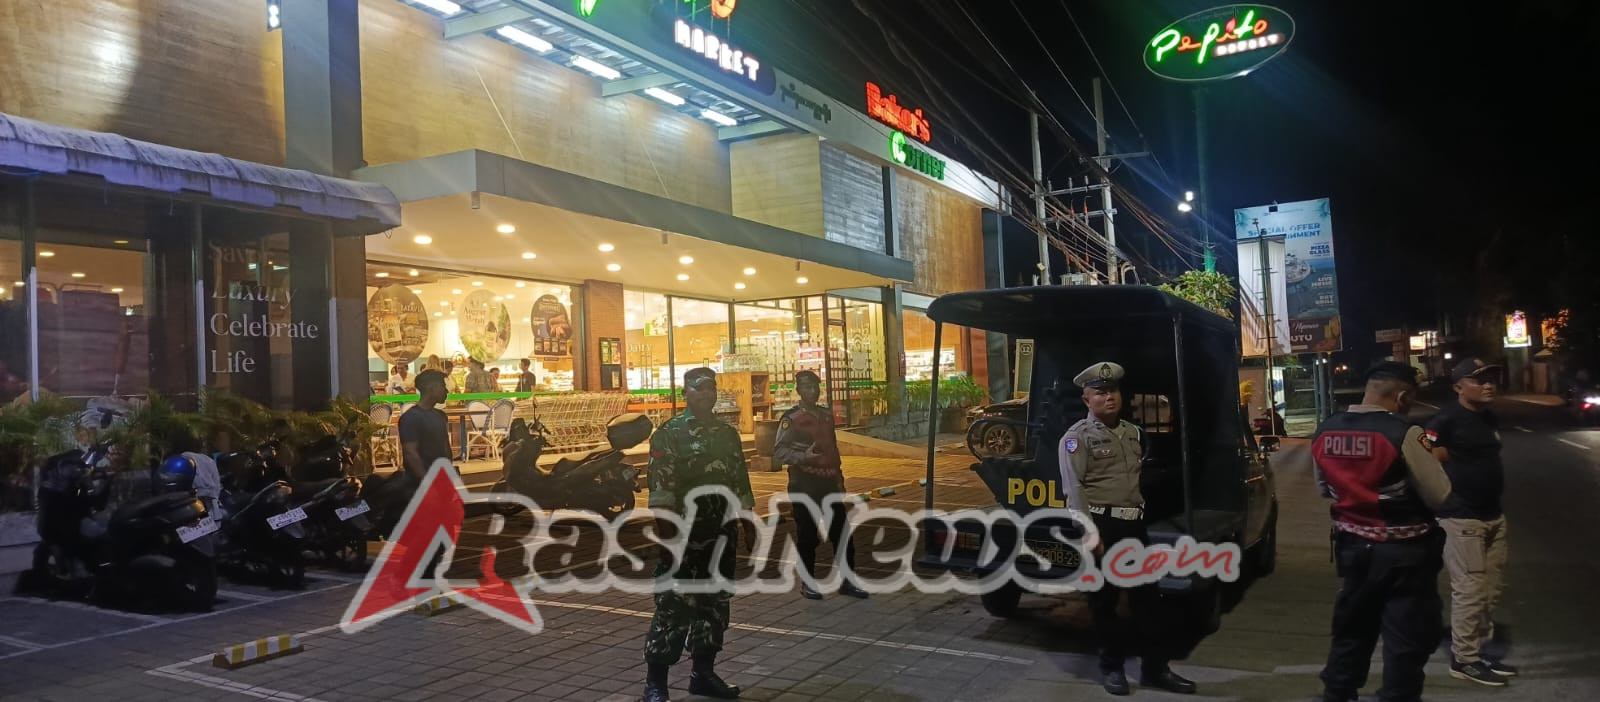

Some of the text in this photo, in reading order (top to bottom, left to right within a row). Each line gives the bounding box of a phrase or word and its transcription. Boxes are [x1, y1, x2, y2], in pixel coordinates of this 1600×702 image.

[674, 19, 760, 81] MARKET
[1151, 10, 1268, 64] Pepito
[866, 81, 932, 143] Baker's
[889, 131, 947, 181] Corner
[1248, 222, 1321, 237] SPCIAL OFFER
[210, 312, 319, 338] Celebrate
[210, 350, 256, 373] Life
[1324, 436, 1372, 456] POLISI
[1007, 477, 1065, 508] POL
